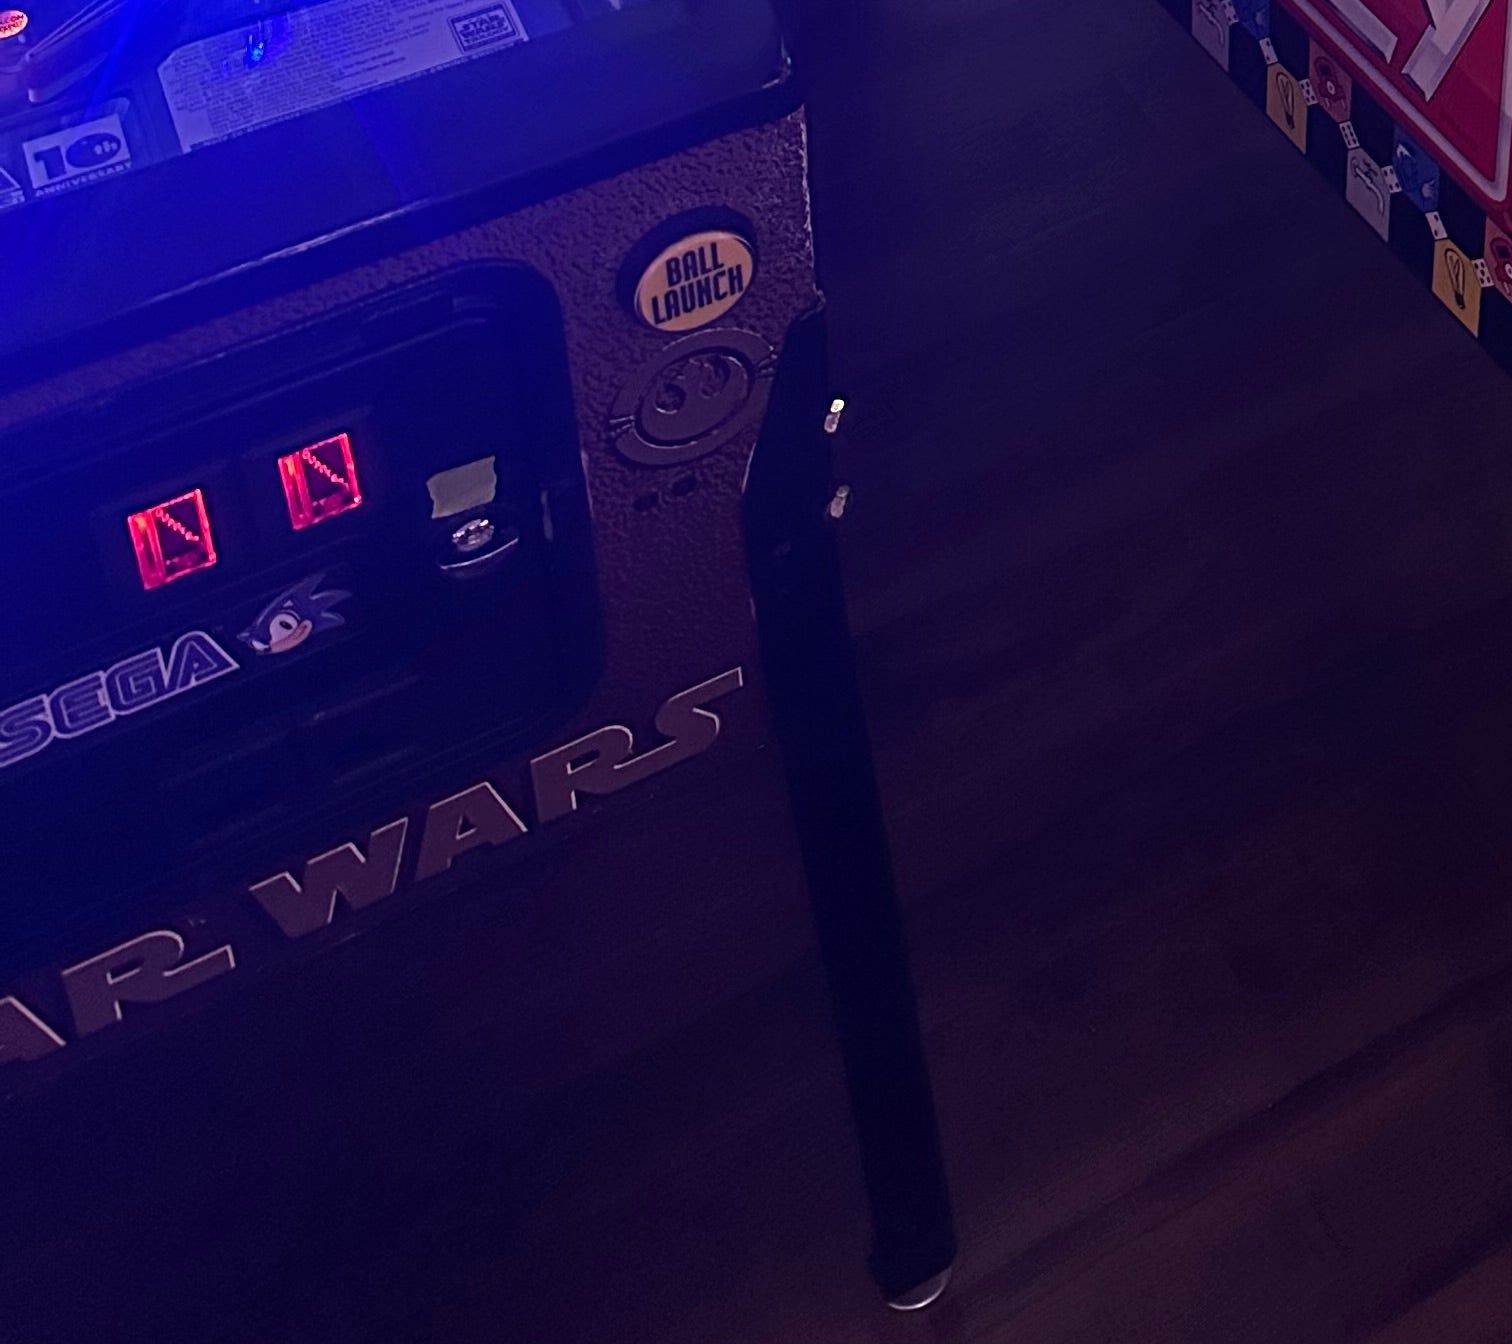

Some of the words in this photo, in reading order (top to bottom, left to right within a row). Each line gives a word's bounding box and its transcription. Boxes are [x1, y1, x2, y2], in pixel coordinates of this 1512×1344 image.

[35, 162, 133, 198] ANNIVERSARY
[651, 264, 745, 331] LAUNCH
[665, 241, 725, 291] BALL
[0, 630, 240, 766] SEGA
[249, 667, 743, 939] WARS
